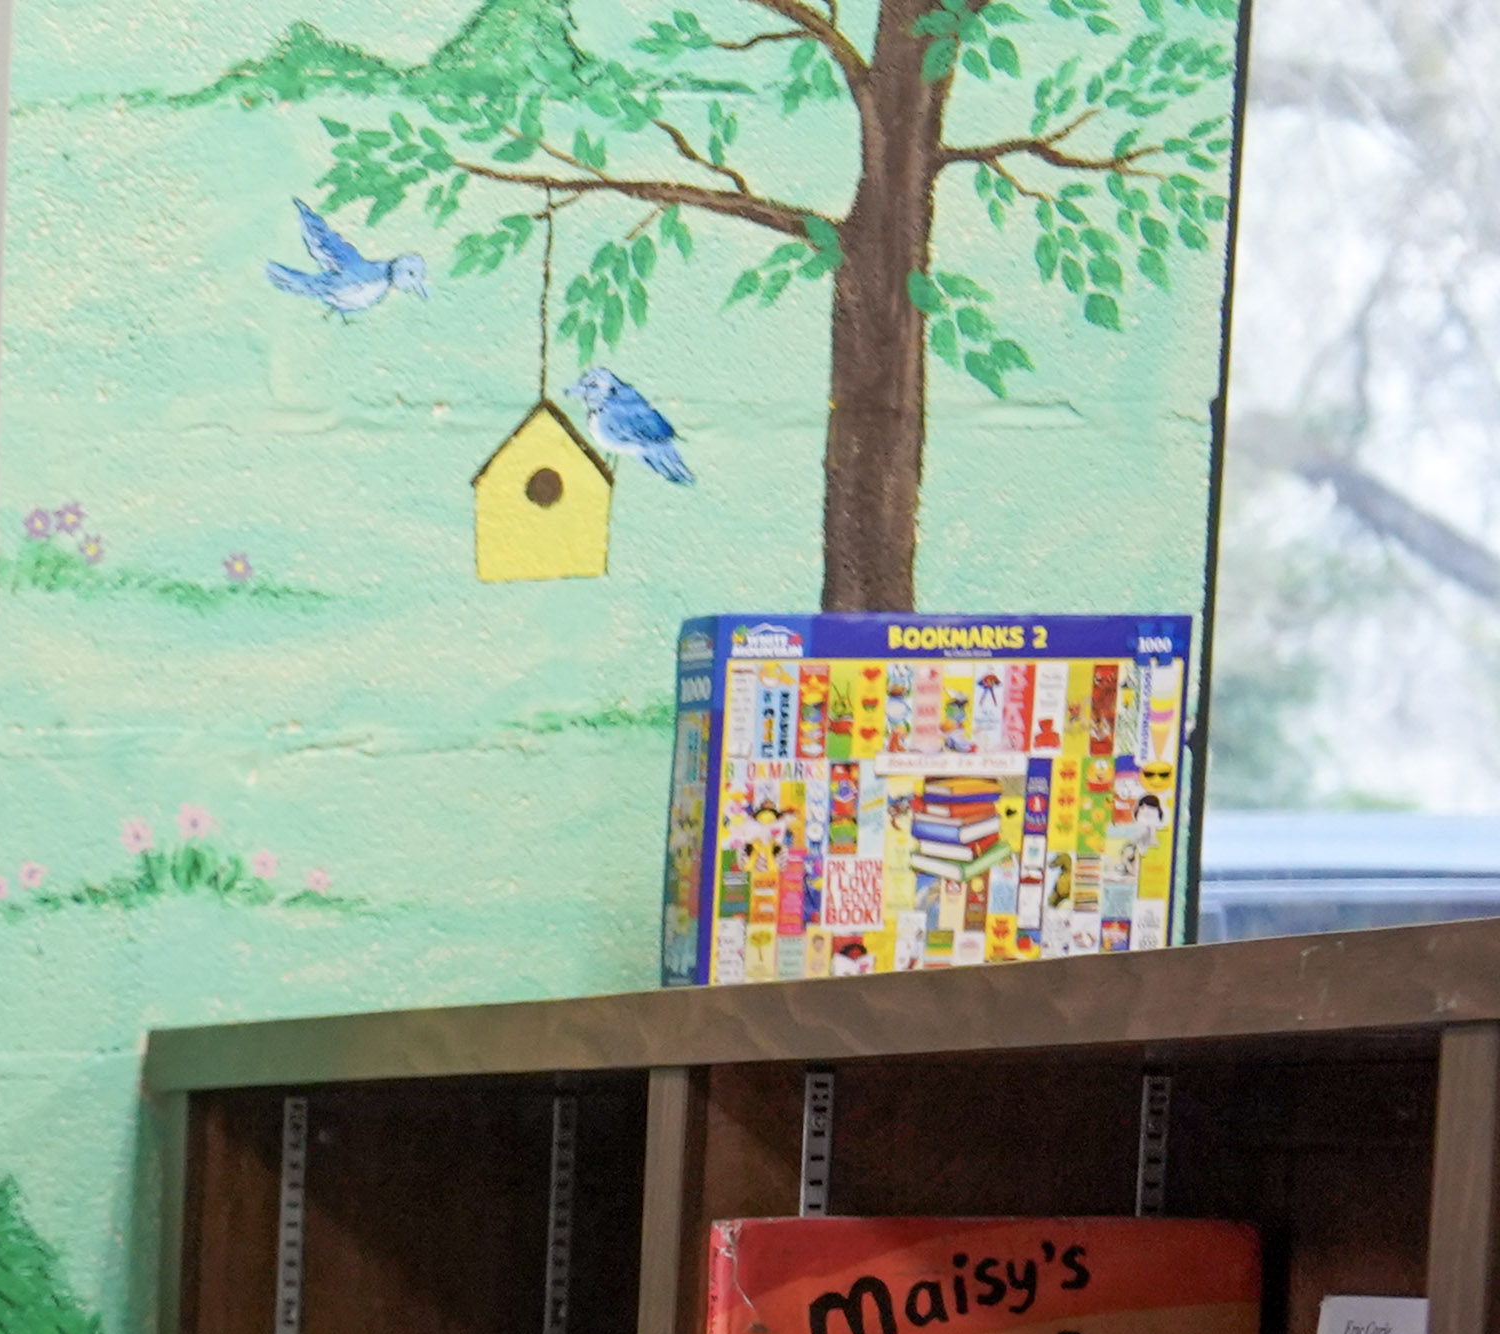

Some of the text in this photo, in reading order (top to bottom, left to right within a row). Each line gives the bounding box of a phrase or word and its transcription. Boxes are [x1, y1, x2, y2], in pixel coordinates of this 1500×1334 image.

[888, 625, 1048, 650] BOOKMARKS 2
[1138, 637, 1173, 653] 1000
[826, 907, 882, 925] BOOK!
